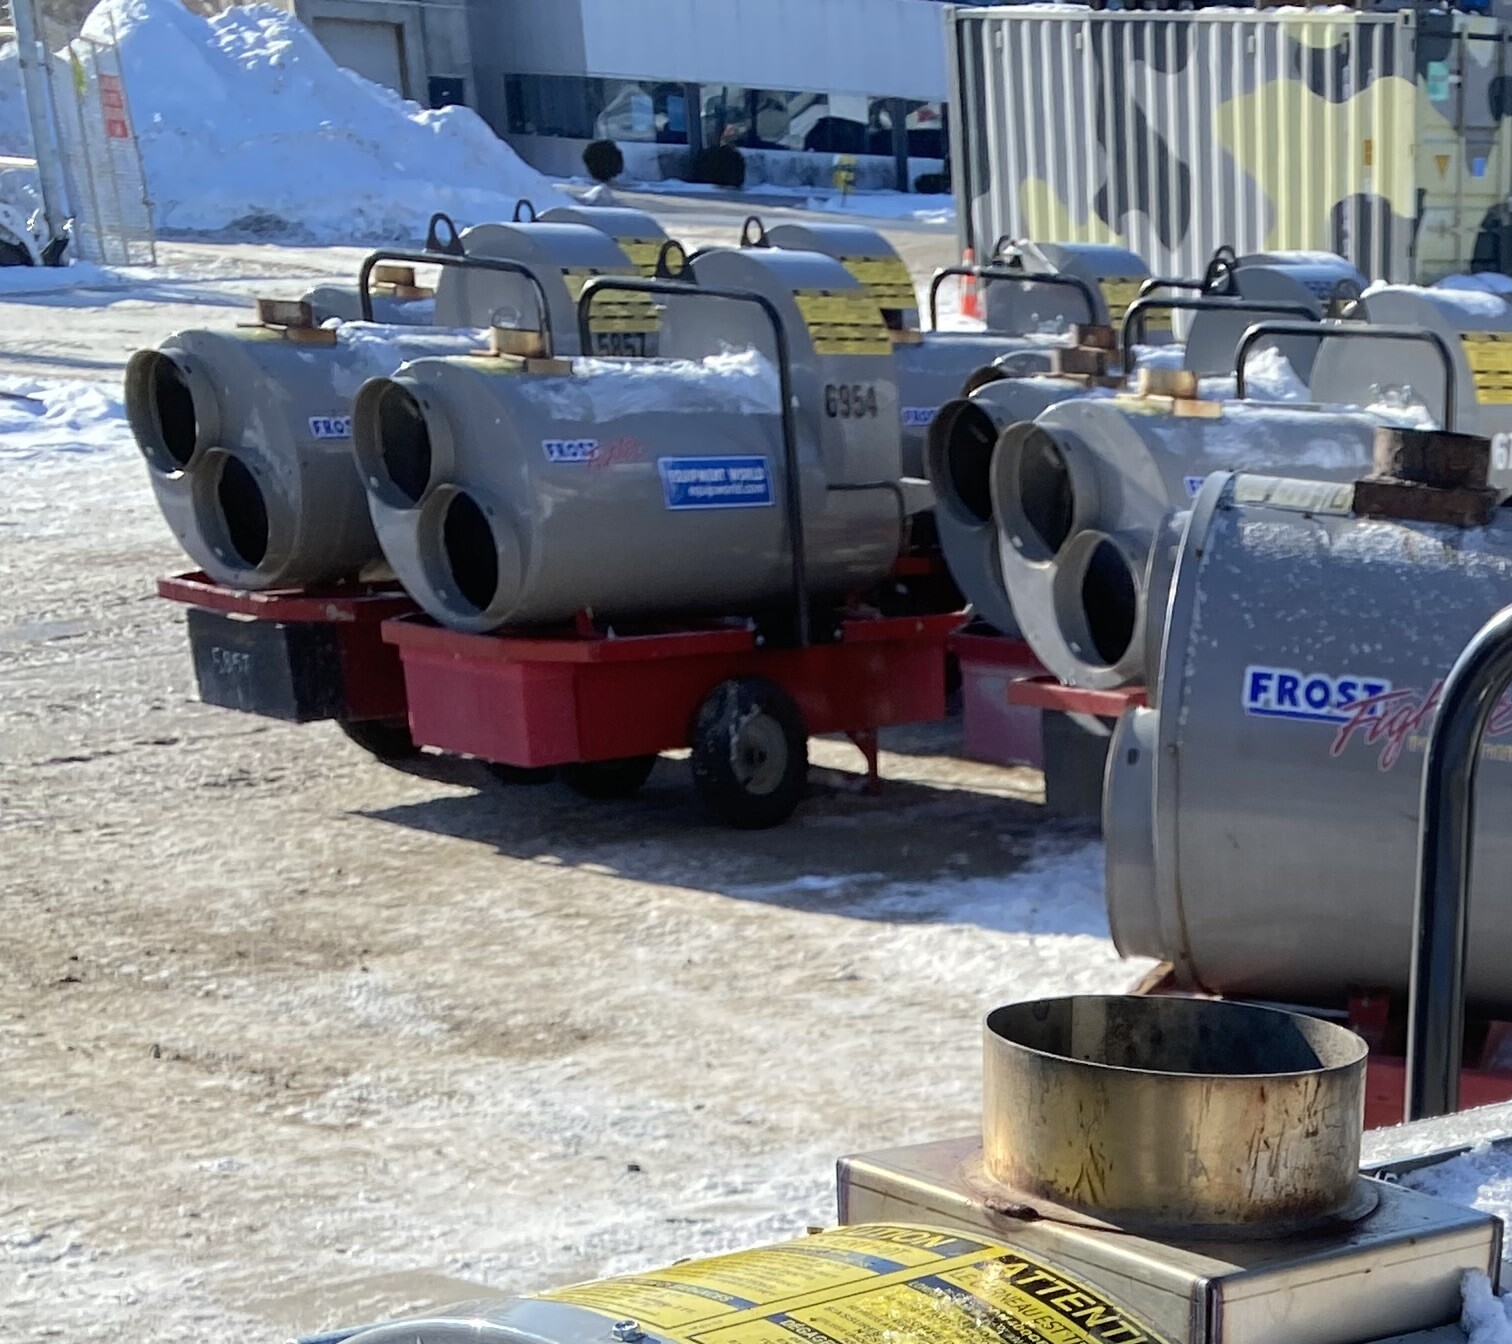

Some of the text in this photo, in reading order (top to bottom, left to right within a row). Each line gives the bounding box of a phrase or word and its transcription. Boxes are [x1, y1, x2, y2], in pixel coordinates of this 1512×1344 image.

[825, 384, 878, 418] 6954
[1249, 670, 1387, 717] FROST
[1029, 1313, 1072, 1334] EST
